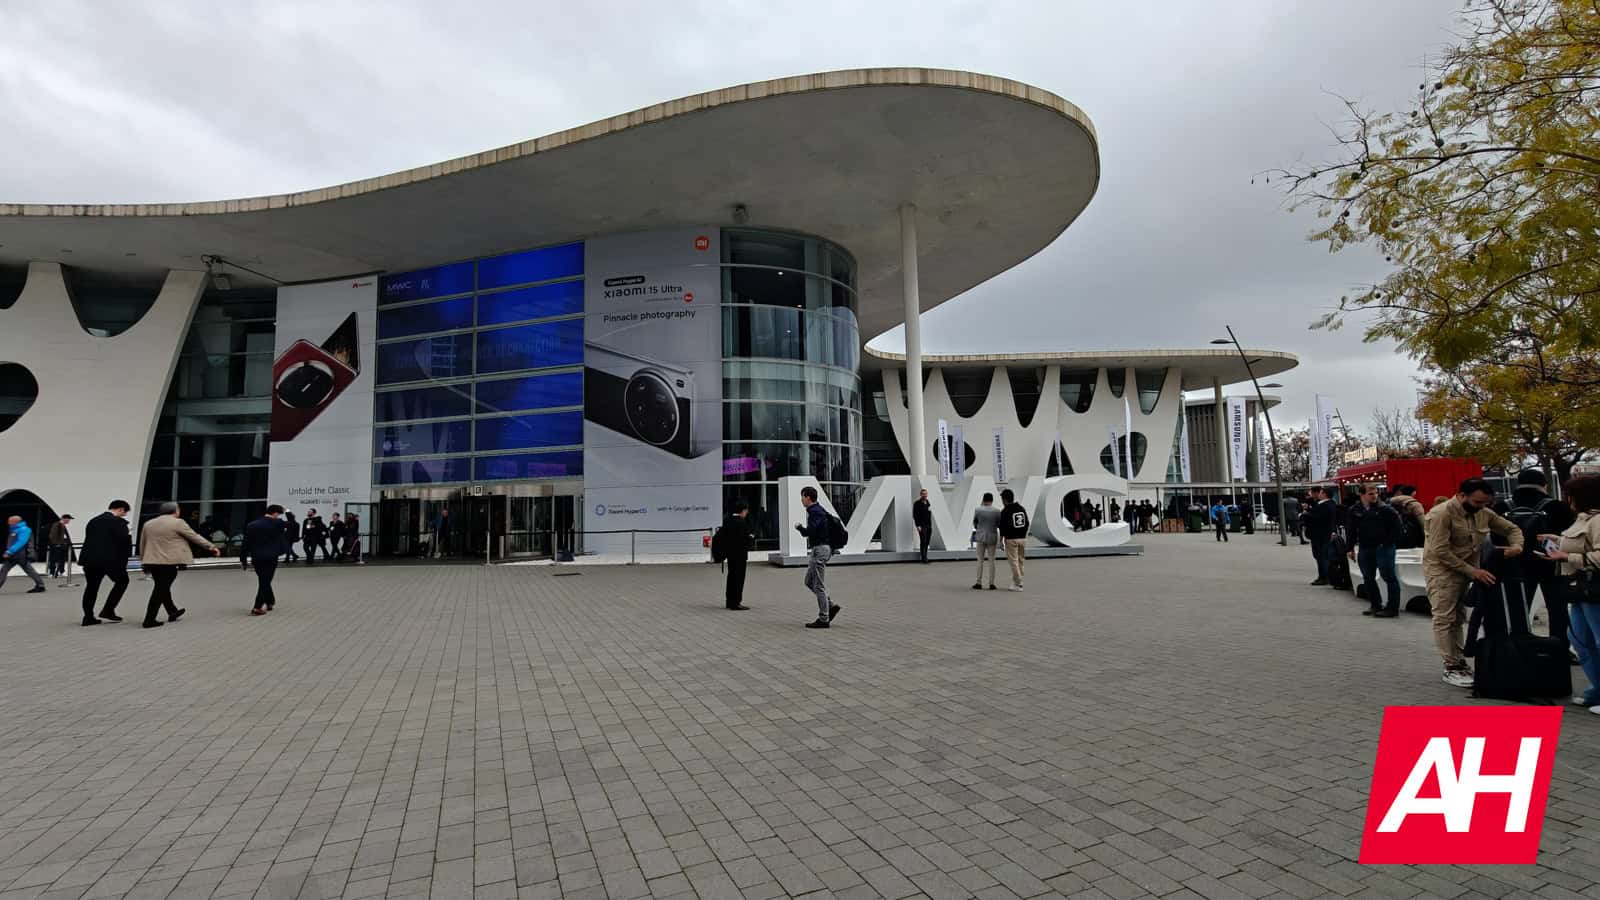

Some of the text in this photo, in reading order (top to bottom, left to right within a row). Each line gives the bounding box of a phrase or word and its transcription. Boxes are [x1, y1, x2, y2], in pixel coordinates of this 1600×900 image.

[604, 286, 646, 299] xiaomi
[648, 285, 658, 294] 15
[661, 284, 682, 294] Ultra
[603, 309, 696, 322] Pinnacle photography
[1233, 404, 1241, 443] SAMSUNG
[288, 486, 350, 496] Unfold the Classic
[778, 475, 1131, 557] MWC
